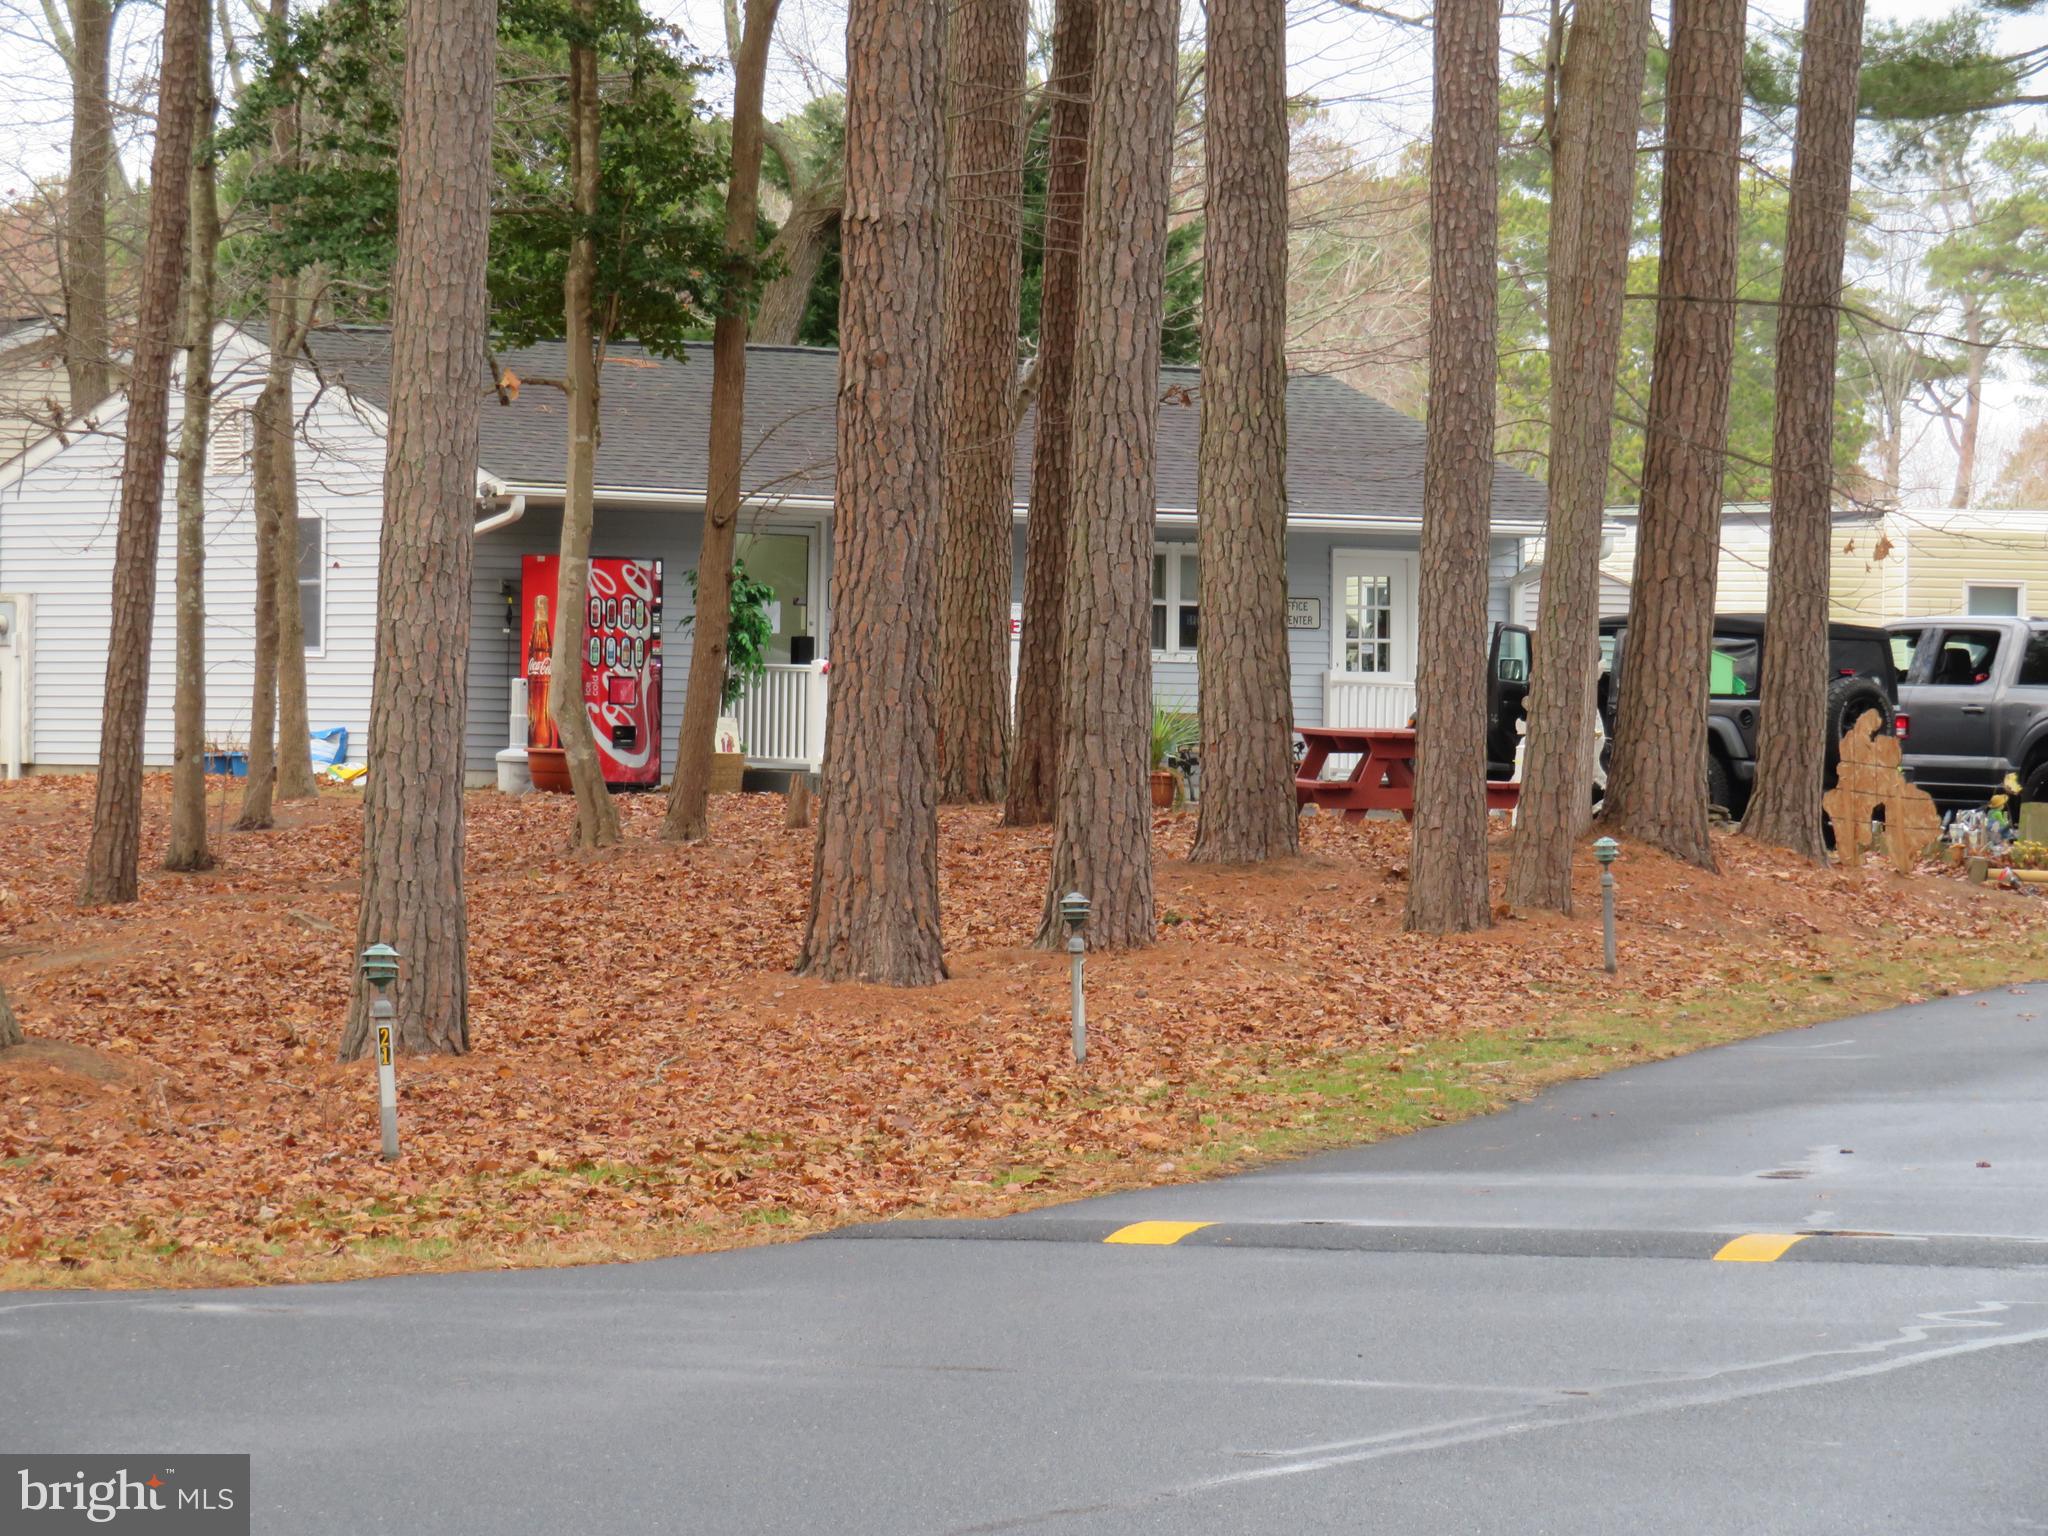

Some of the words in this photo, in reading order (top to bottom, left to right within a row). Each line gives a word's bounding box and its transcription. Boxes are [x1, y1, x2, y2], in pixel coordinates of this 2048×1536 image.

[1288, 601, 1309, 611] FFICE
[1288, 615, 1313, 625] ENTER
[380, 1028, 390, 1065] 21
